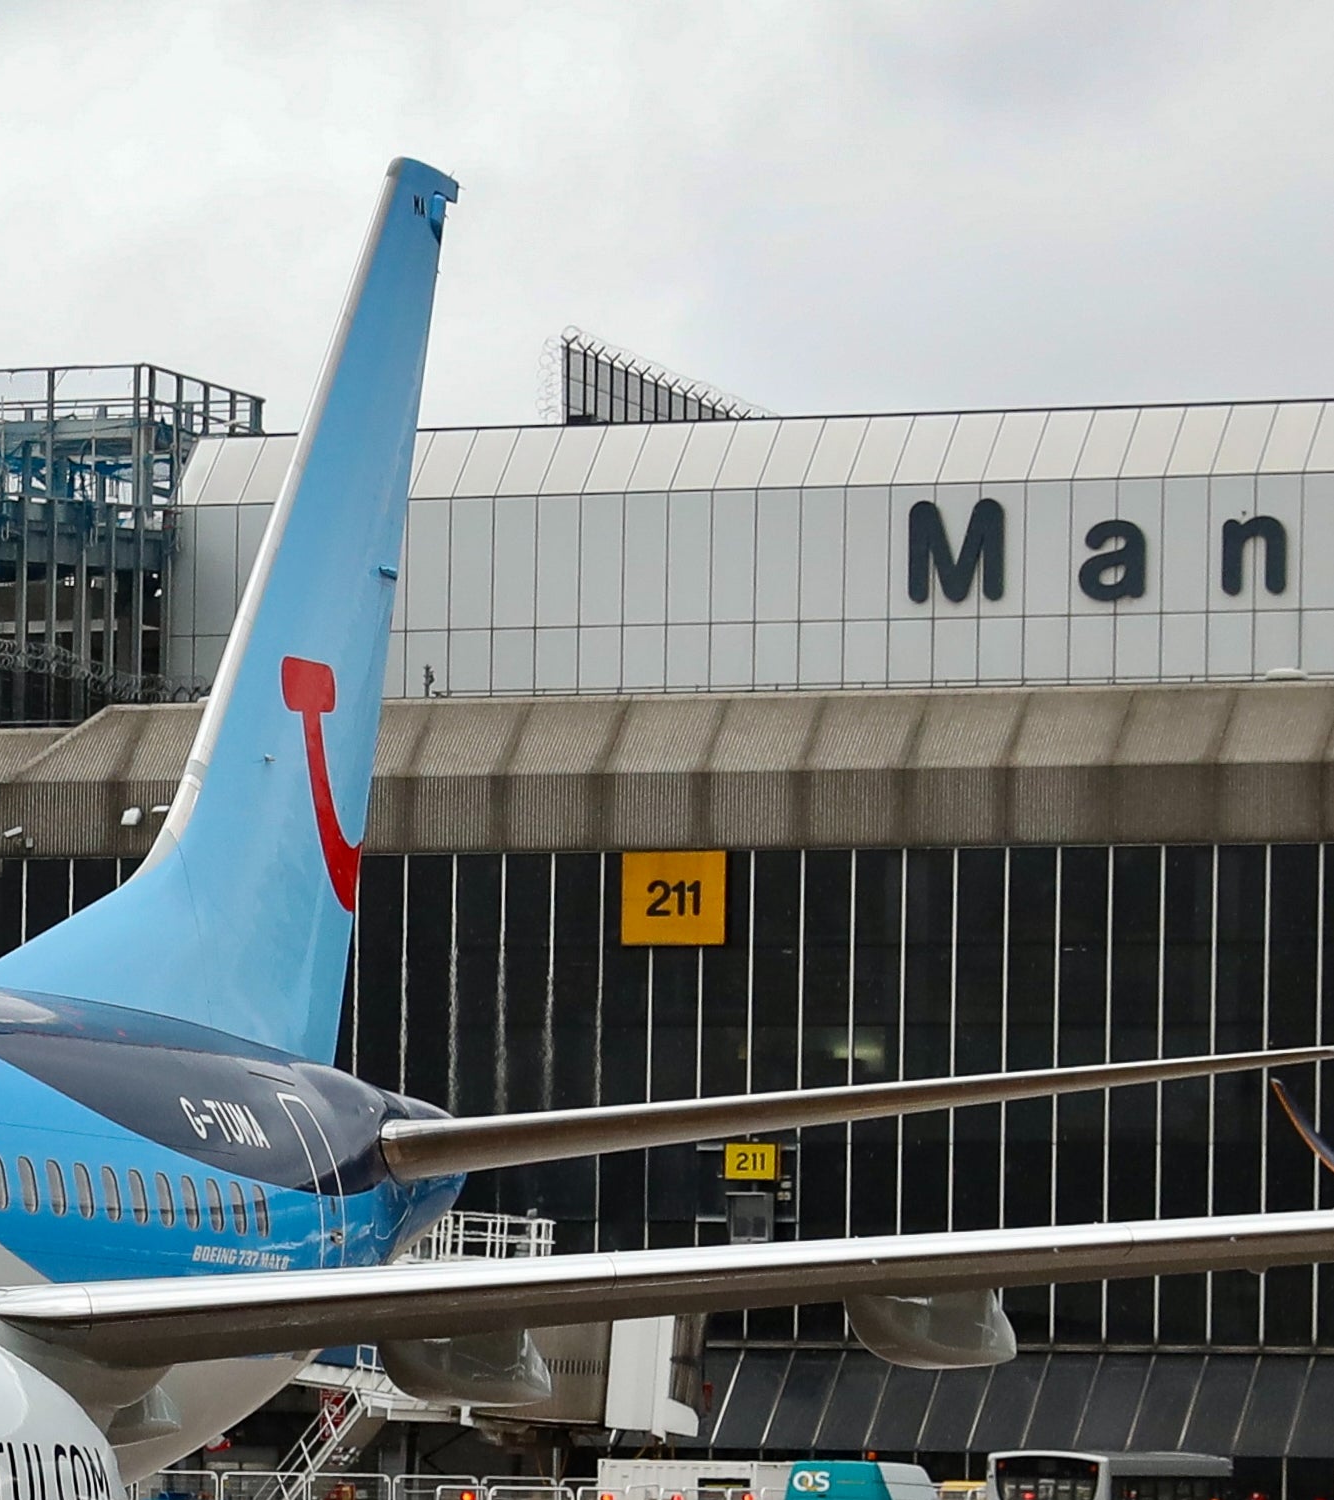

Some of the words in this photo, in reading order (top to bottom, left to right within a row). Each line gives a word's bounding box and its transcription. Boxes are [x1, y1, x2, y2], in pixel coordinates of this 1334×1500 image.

[907, 496, 1288, 604] Man
[646, 880, 702, 917] 211
[179, 1096, 272, 1149] G-TUMA
[736, 1152, 766, 1171] 211
[192, 1244, 238, 1265] BOEING
[237, 1249, 260, 1267] 737
